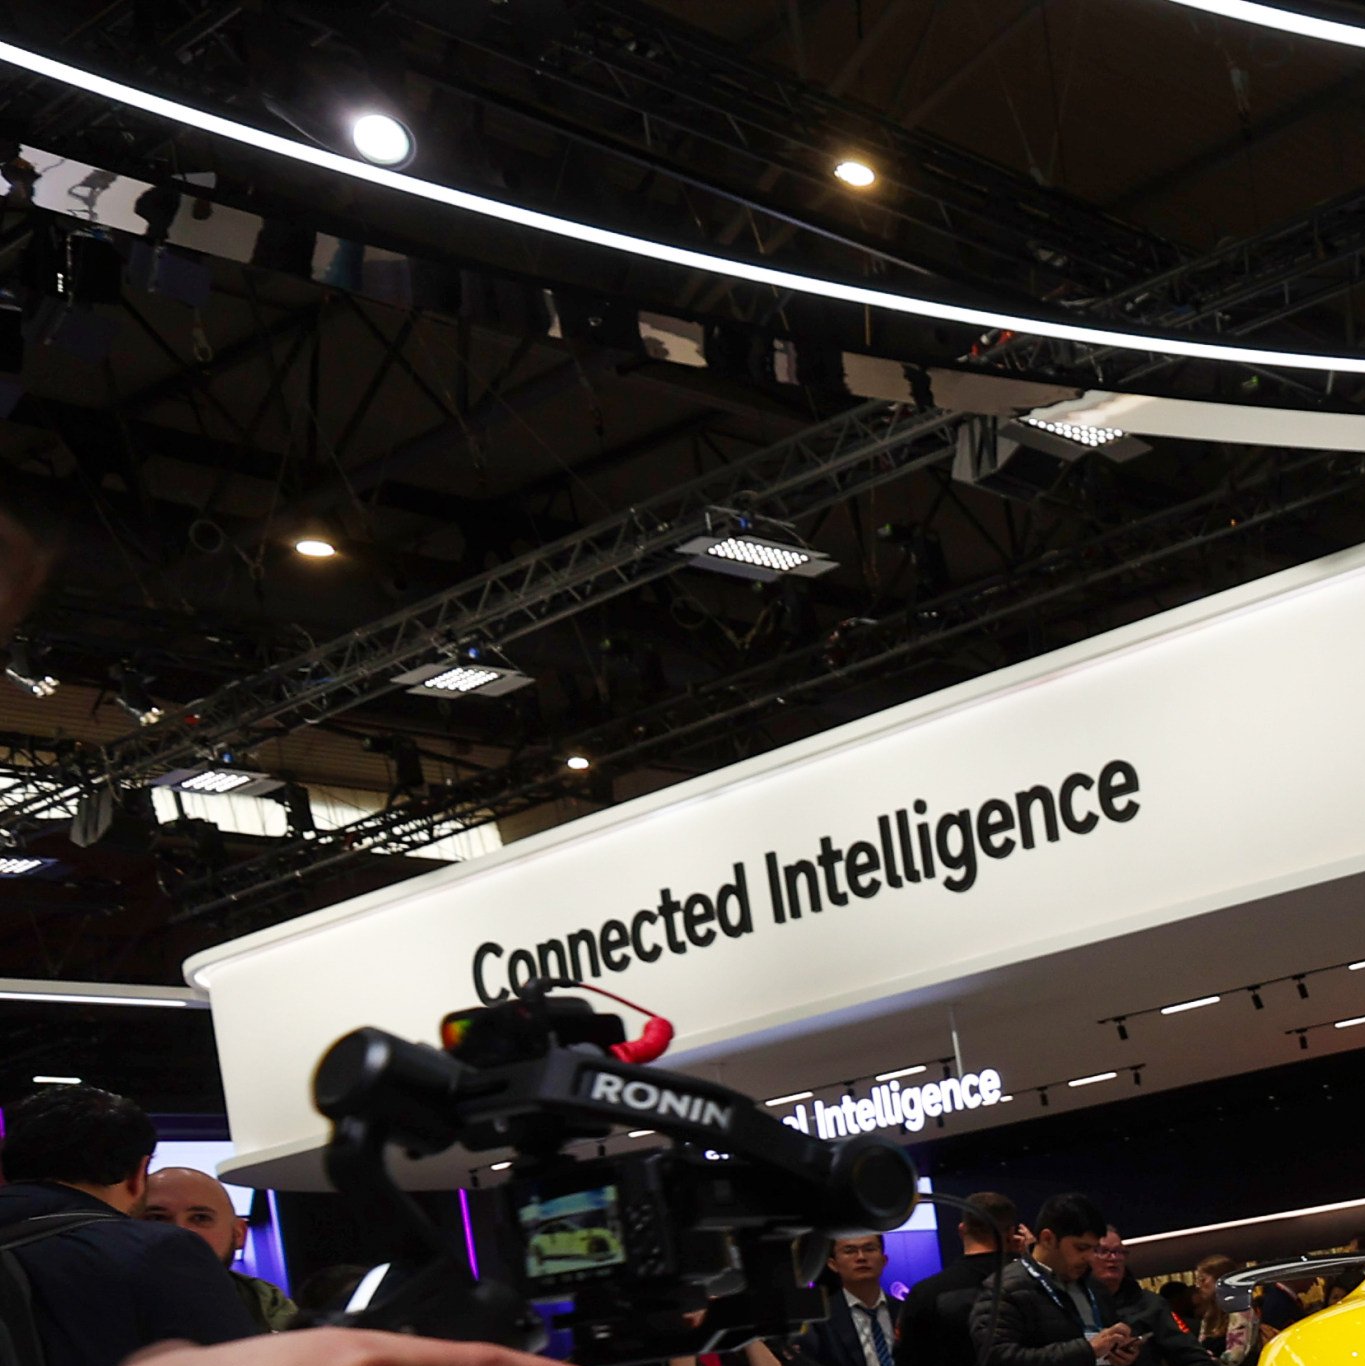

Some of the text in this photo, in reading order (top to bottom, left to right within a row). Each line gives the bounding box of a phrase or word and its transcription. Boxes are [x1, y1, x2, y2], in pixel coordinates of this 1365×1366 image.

[472, 759, 1140, 1007] Connected Intelligence
[591, 1071, 733, 1130] RONIN
[813, 1067, 1002, 1140] Intelligence
